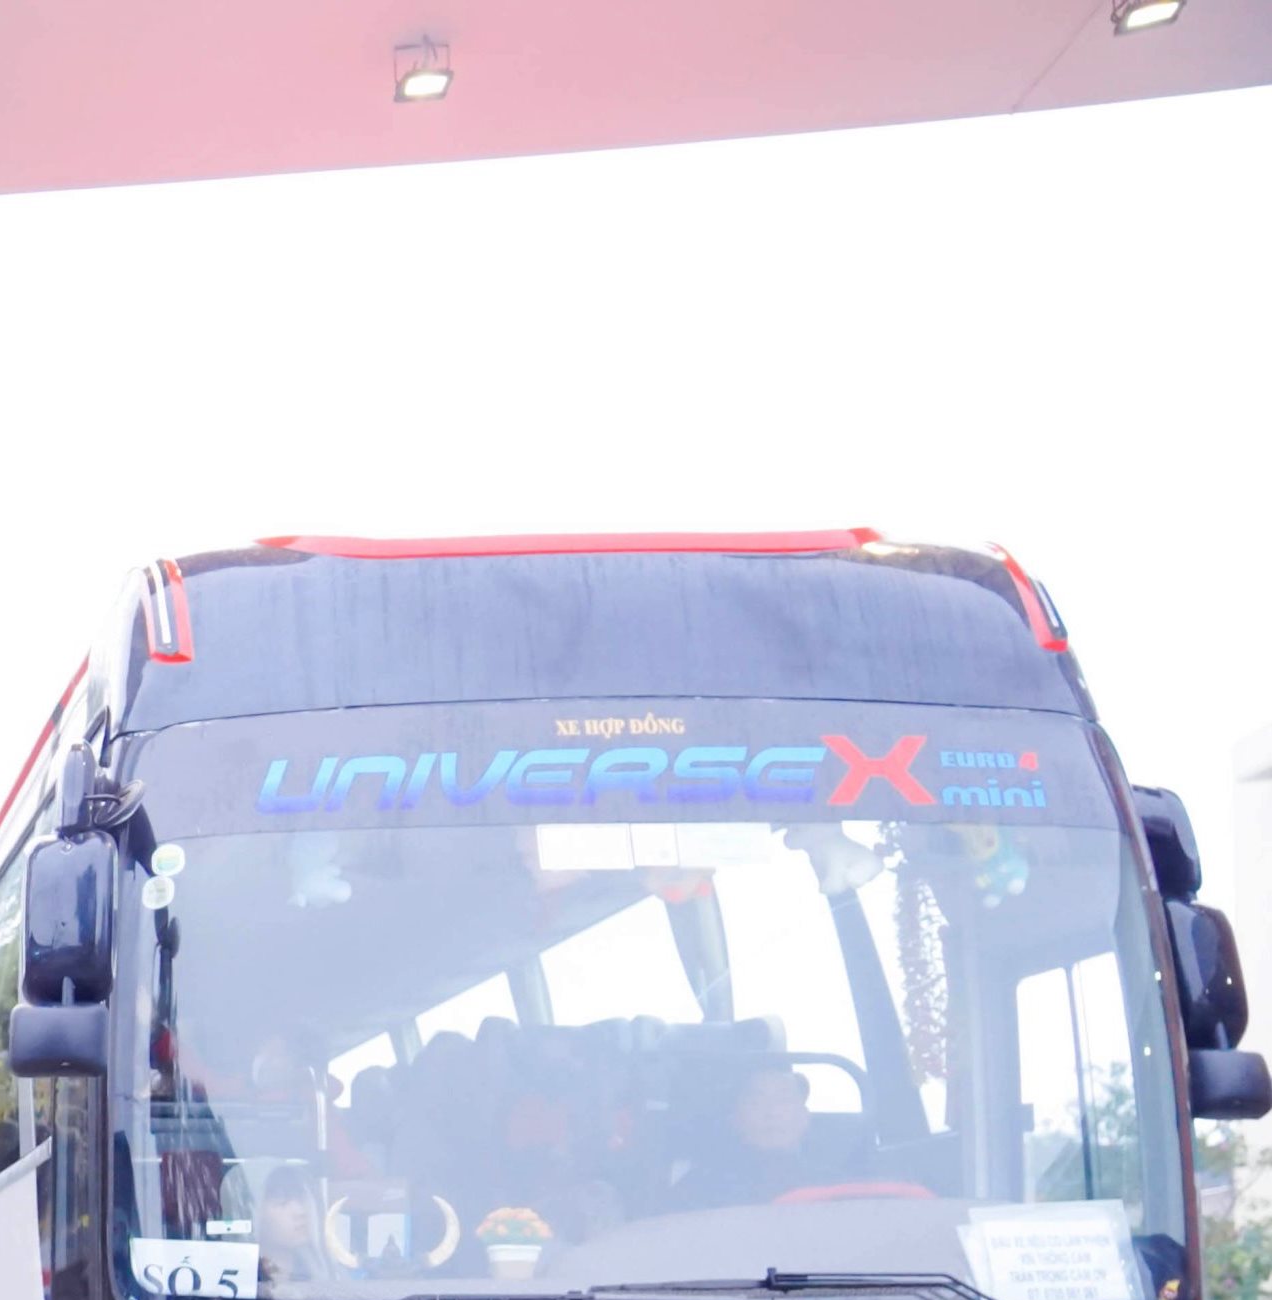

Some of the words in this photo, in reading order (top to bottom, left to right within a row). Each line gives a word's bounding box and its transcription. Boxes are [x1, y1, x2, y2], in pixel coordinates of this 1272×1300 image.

[555, 719, 581, 736] XE
[941, 778, 1047, 808] mini
[143, 1256, 201, 1296] SỐ
[218, 1269, 239, 1298] 5
